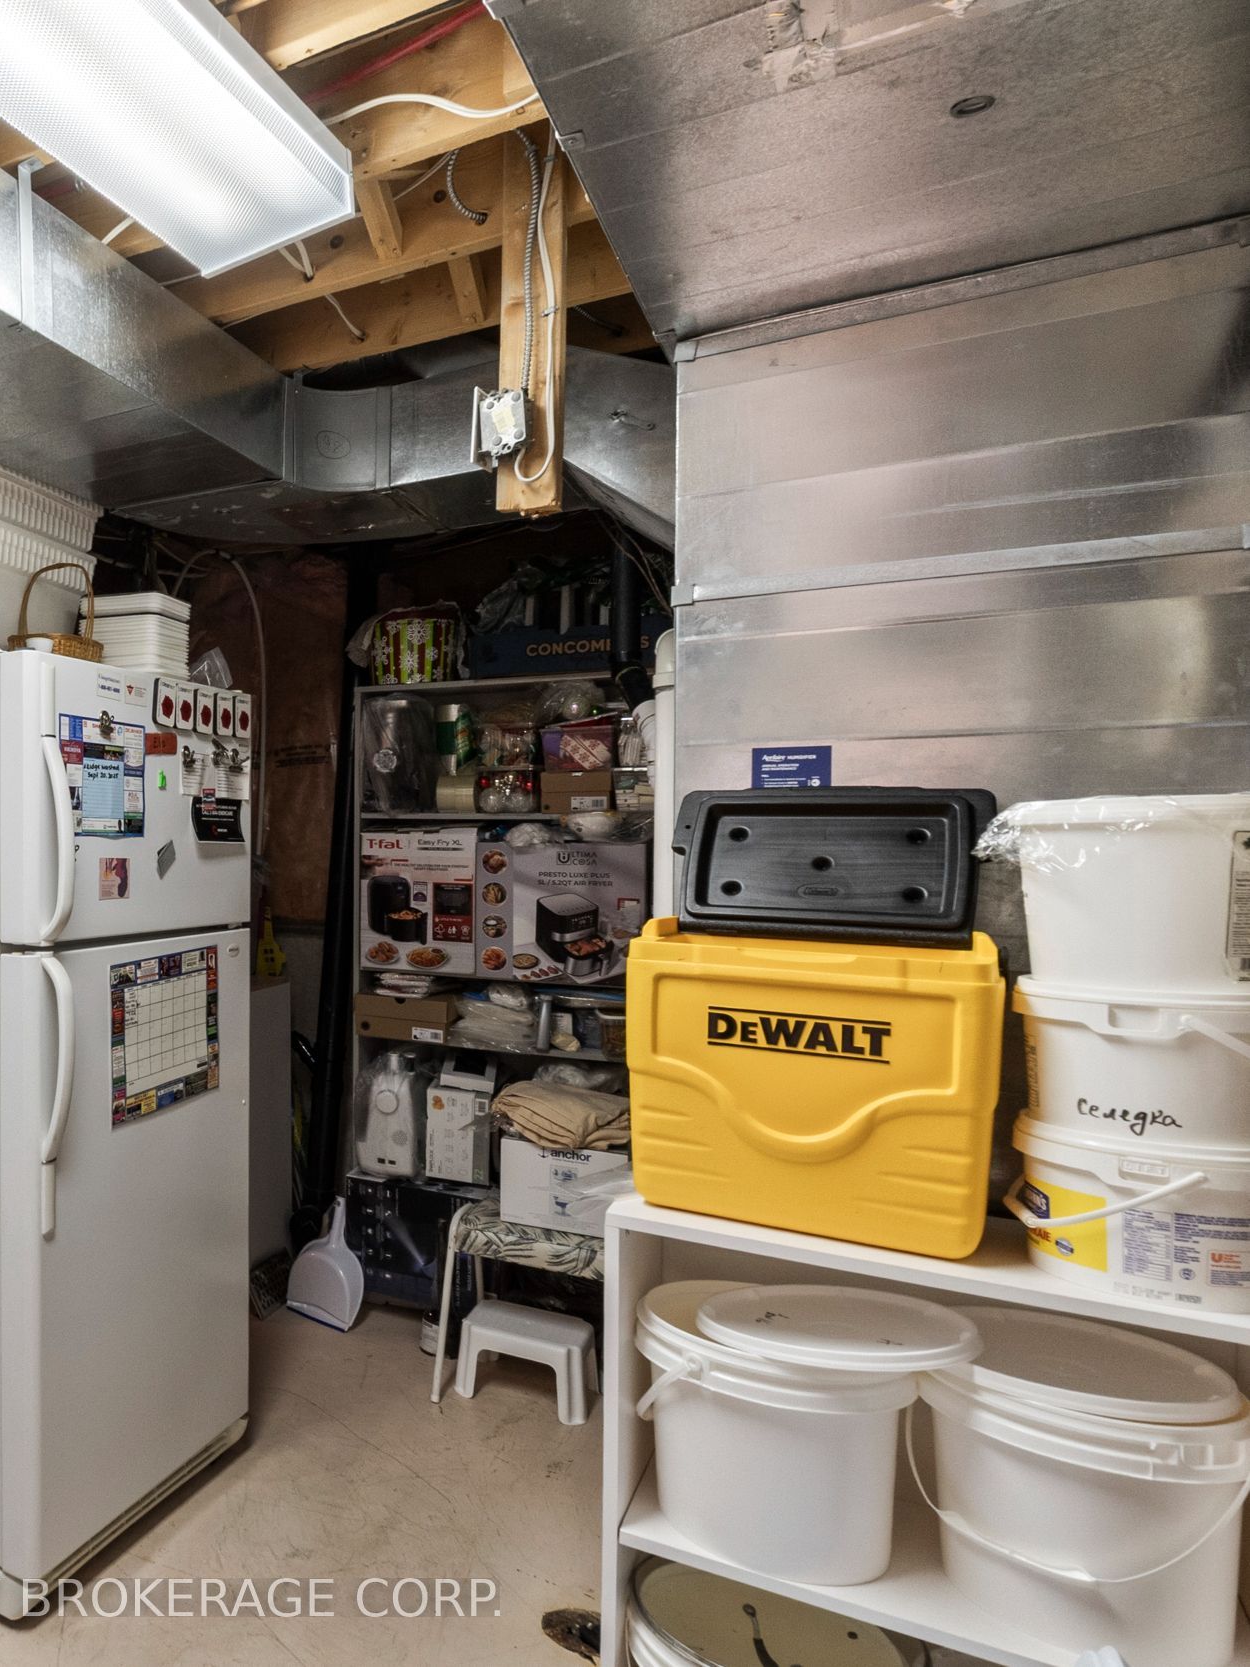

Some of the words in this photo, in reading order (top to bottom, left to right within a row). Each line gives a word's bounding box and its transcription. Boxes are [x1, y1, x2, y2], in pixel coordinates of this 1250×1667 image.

[417, 839, 435, 847] Easy
[437, 839, 450, 848] Fry
[538, 871, 568, 879] PRESTO
[550, 1149, 592, 1163] anchor
